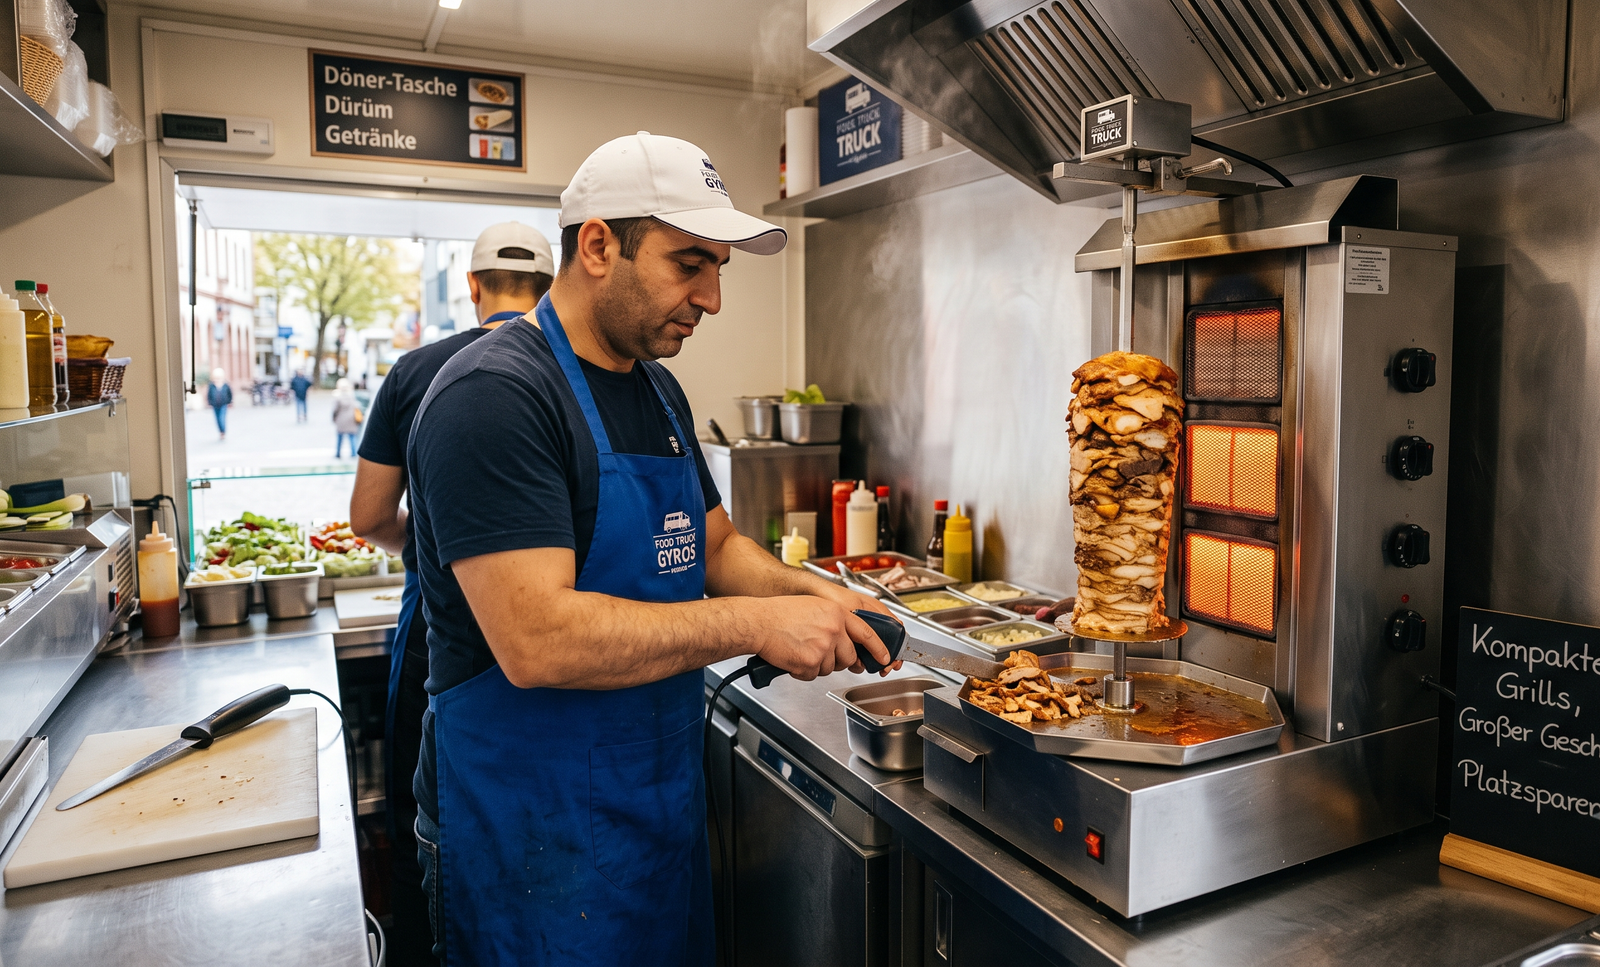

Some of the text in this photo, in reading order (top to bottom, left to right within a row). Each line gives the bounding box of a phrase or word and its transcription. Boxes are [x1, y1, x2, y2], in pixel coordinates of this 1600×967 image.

[324, 65, 457, 97] Döner-Tasche
[325, 94, 393, 120] Dürüm
[325, 124, 417, 150] Getränke
[836, 120, 881, 158] TRUCK
[1091, 127, 1122, 145] TRUCK
[654, 537, 674, 550] FOOD
[657, 543, 696, 568] GYROS
[1496, 672, 1580, 718] Grills,
[1458, 706, 1533, 748] Großer
